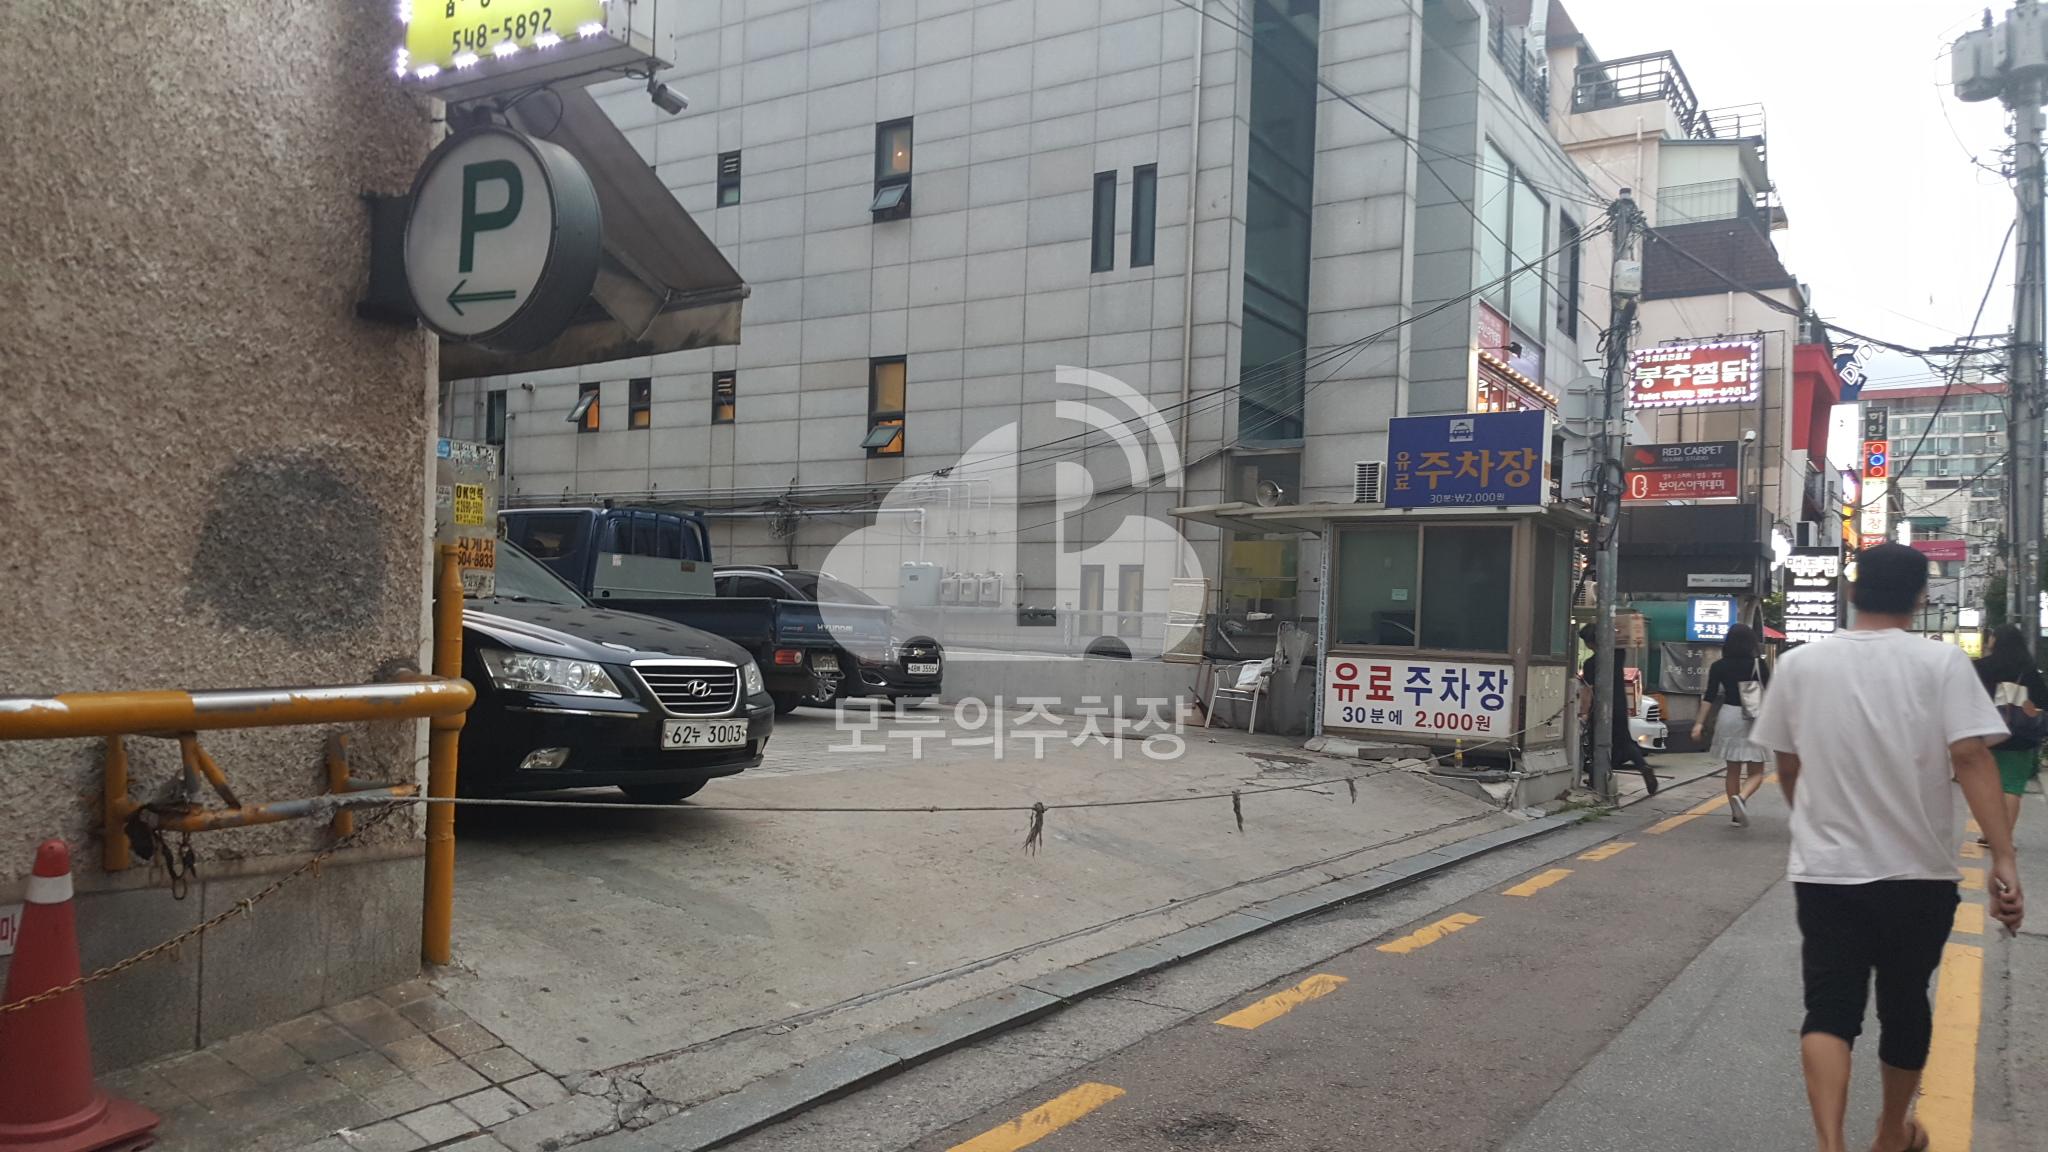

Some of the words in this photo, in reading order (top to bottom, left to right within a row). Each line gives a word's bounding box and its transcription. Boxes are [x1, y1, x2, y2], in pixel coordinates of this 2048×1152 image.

[452, 8, 552, 54] 548-5892
[458, 159, 524, 273] P
[1635, 359, 1750, 389] 봉추찜닭
[1662, 448, 1681, 456] RED
[1684, 446, 1724, 455] CARPET
[1394, 452, 1412, 490] 유료
[1415, 447, 1539, 490] 주차장
[1658, 480, 1725, 491] 보이스아카데미
[817, 623, 853, 632] HYUNDAI
[1693, 623, 1728, 634] 주차장
[1332, 662, 1394, 703] 유료
[1404, 666, 1509, 711] 주차장
[1342, 706, 1403, 726] 30분에
[1414, 710, 1491, 732] 2,000원
[672, 726, 701, 744] 62누
[707, 725, 741, 743] 3003
